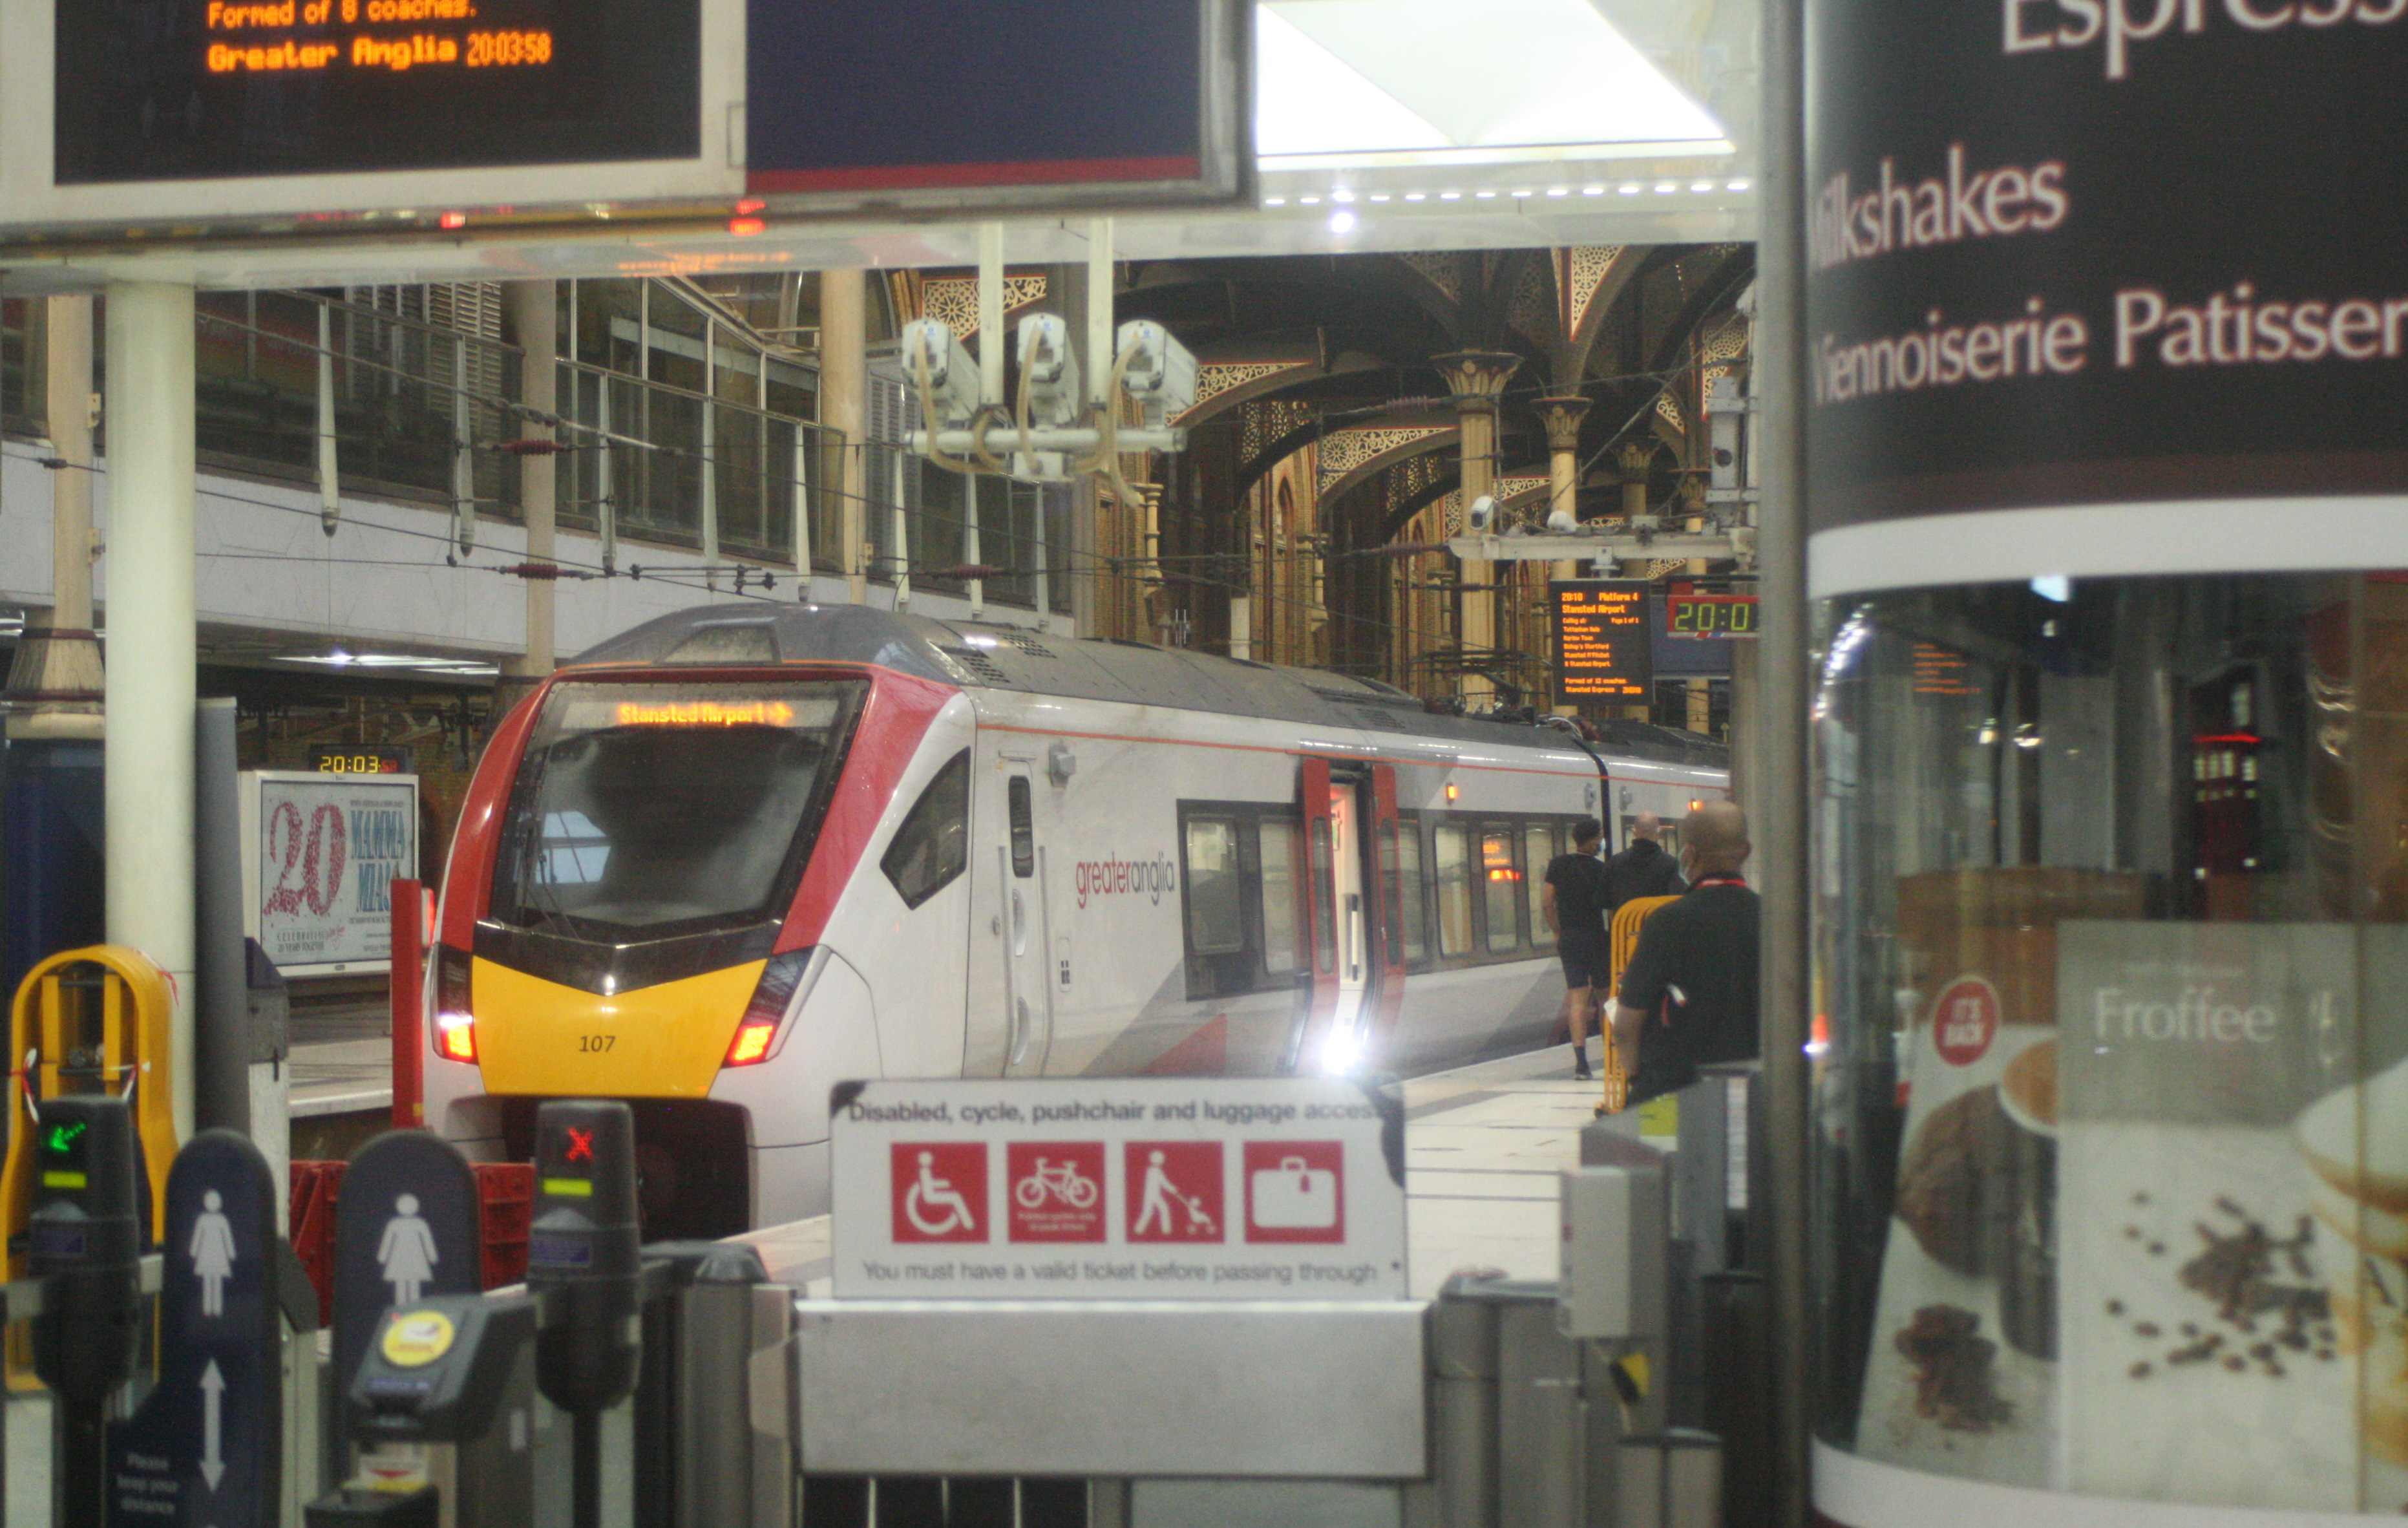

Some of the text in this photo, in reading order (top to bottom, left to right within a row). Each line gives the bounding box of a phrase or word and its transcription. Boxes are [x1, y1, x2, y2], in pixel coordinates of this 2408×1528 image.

[209, 0, 477, 28] Formed of 8 coaches.
[208, 31, 552, 72] Greater Anglia 20:03:58
[1561, 592, 1638, 602] 20:10 Platform 4
[1562, 604, 1625, 614] Stansted Airport
[1674, 602, 1759, 631] 20:0
[620, 704, 765, 726] Stansted Airport
[320, 756, 379, 773] 20:03
[350, 810, 405, 860] MAMMA
[263, 801, 346, 917] 20
[1076, 851, 1175, 909] greateranglia
[2095, 984, 2277, 1043] Froffee
[578, 1035, 617, 1053] 107
[849, 1100, 1378, 1126] Disabled, cycle, pushchair and luggage acces
[863, 1261, 1378, 1286] You must have a valid ticket before passing through
